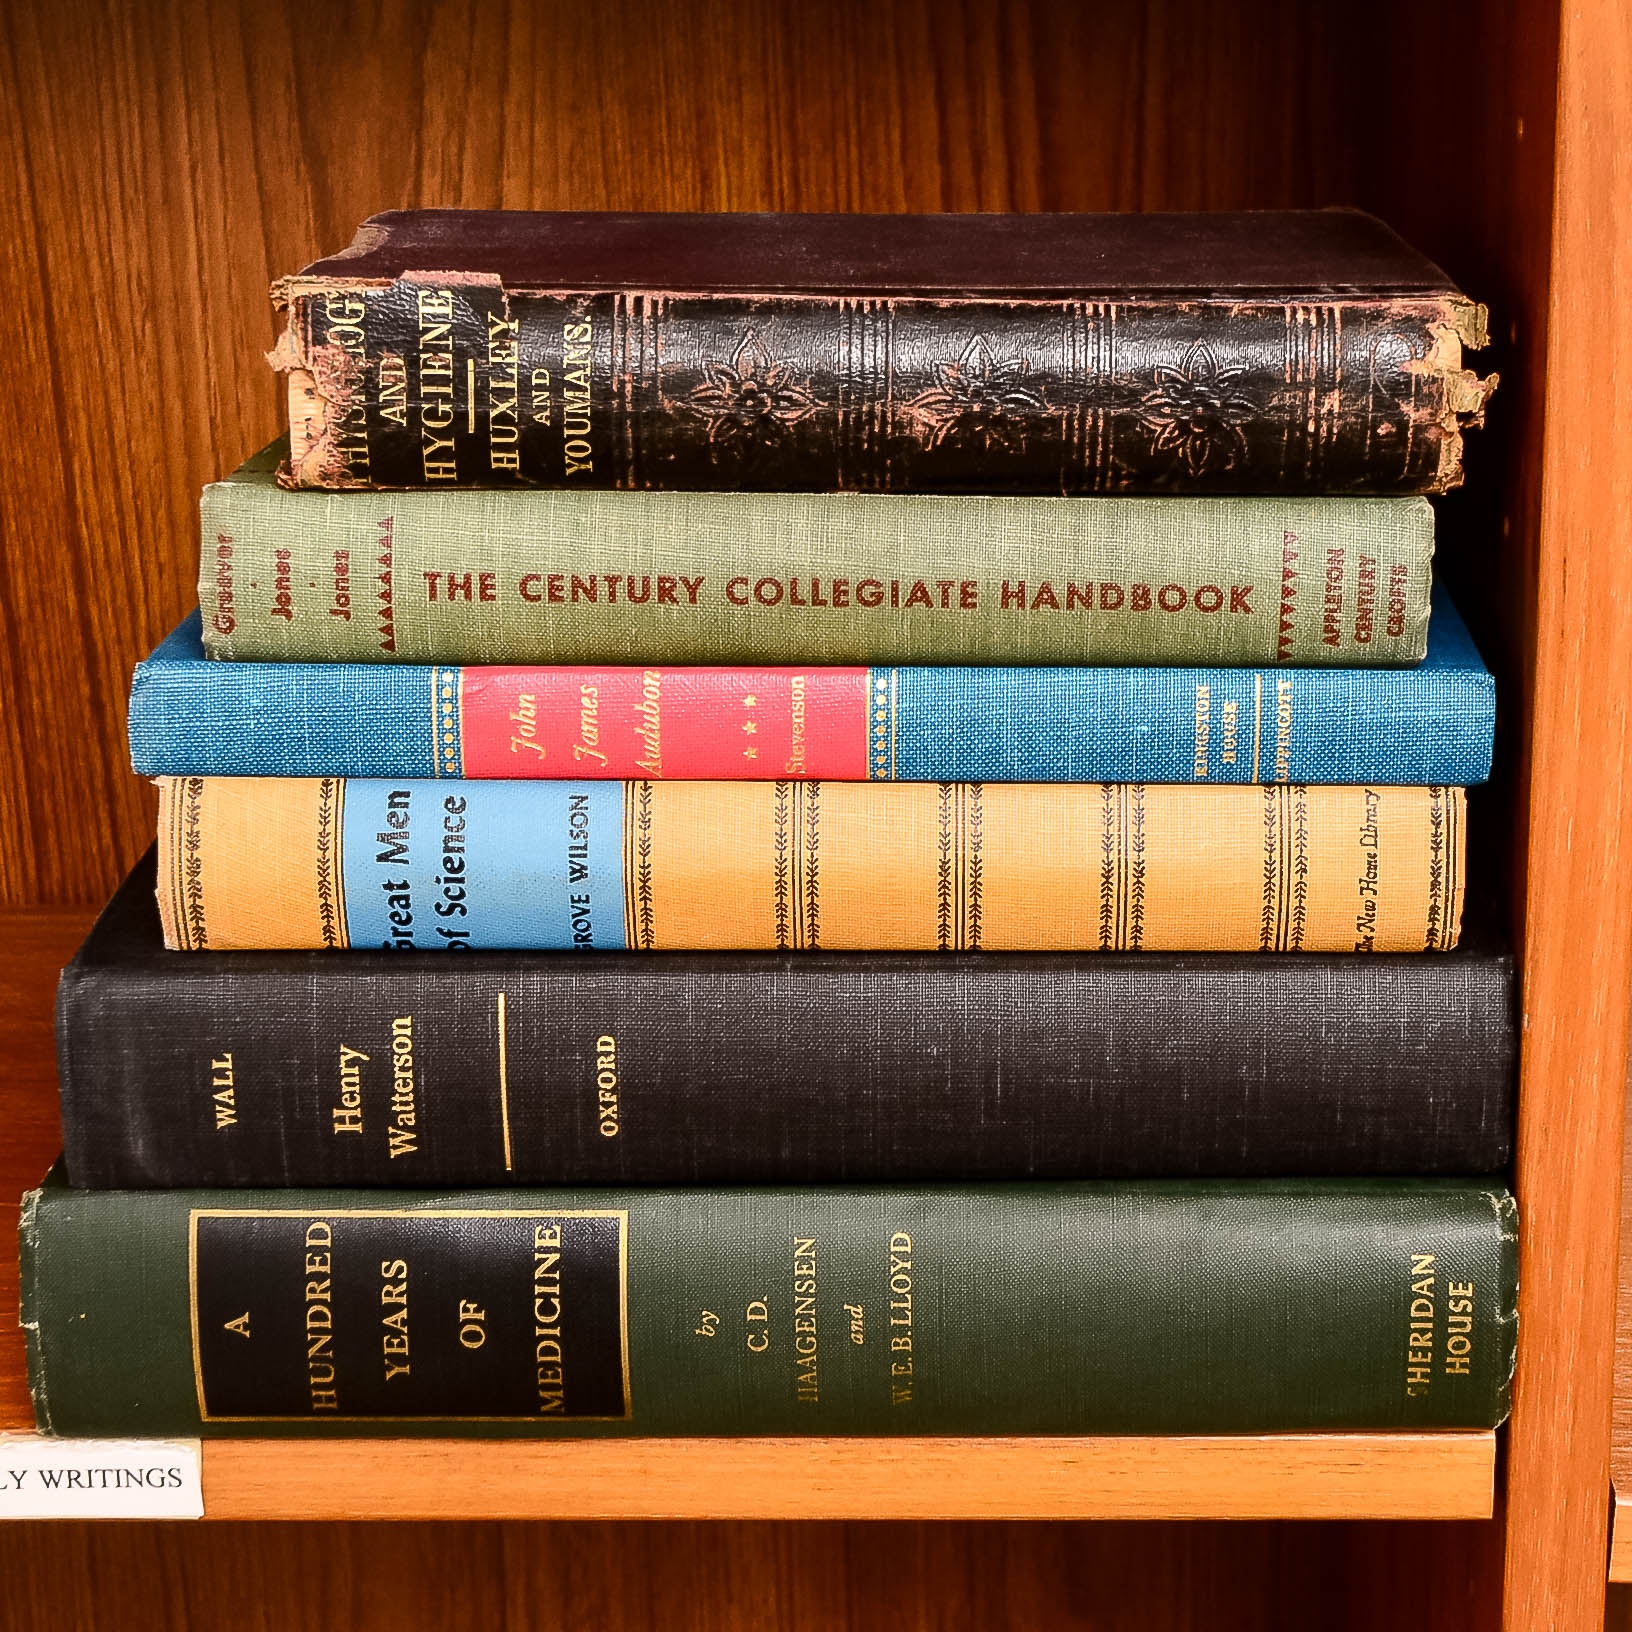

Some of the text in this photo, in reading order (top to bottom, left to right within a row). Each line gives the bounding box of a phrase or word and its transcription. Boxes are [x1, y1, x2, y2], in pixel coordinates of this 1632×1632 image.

[379, 353, 407, 426] AND
[417, 290, 457, 481] HYGIENE
[487, 311, 520, 469] HUXLEY
[532, 369, 550, 426] AND
[562, 315, 593, 475] YOUMANS.
[271, 549, 293, 621] Jones
[329, 550, 351, 621] Jones
[423, 572, 1254, 614] THE CENTURY COLLEGIATE HANDBOOK
[1322, 548, 1344, 648] APPLETON
[1354, 555, 1376, 643] CENTURY
[1387, 565, 1407, 637] CROFTS
[509, 694, 547, 759] John
[572, 685, 609, 766] James
[633, 671, 662, 778] Audubon
[784, 675, 806, 774] Stevenson
[1194, 685, 1210, 777] KINGSTON
[1222, 701, 1238, 764] HOUSE
[1275, 680, 1292, 783] LIPPINCOTT
[376, 790, 411, 864] Men
[568, 795, 589, 883] WILSON
[1360, 789, 1380, 849] Library
[434, 795, 471, 951] of Science
[1357, 899, 1376, 932] New
[1359, 853, 1378, 896] Home
[212, 1053, 237, 1129] WALL
[332, 1044, 370, 1134] Henry
[388, 1015, 419, 1158] Watterson
[596, 1034, 619, 1137] OXFORD
[223, 1312, 250, 1339] A
[305, 1221, 338, 1410] HUNDRED
[381, 1259, 411, 1381] YEARS
[459, 1299, 486, 1349] OF
[535, 1225, 565, 1412] MEDICINE
[696, 1310, 720, 1337] by
[794, 1236, 818, 1402] HAAGENSEN
[844, 1304, 864, 1344] and
[1407, 1254, 1436, 1397] SHERIDAN
[1446, 1282, 1473, 1374] HOUSE
[0, 1467, 183, 1490] Y WRITINGS
